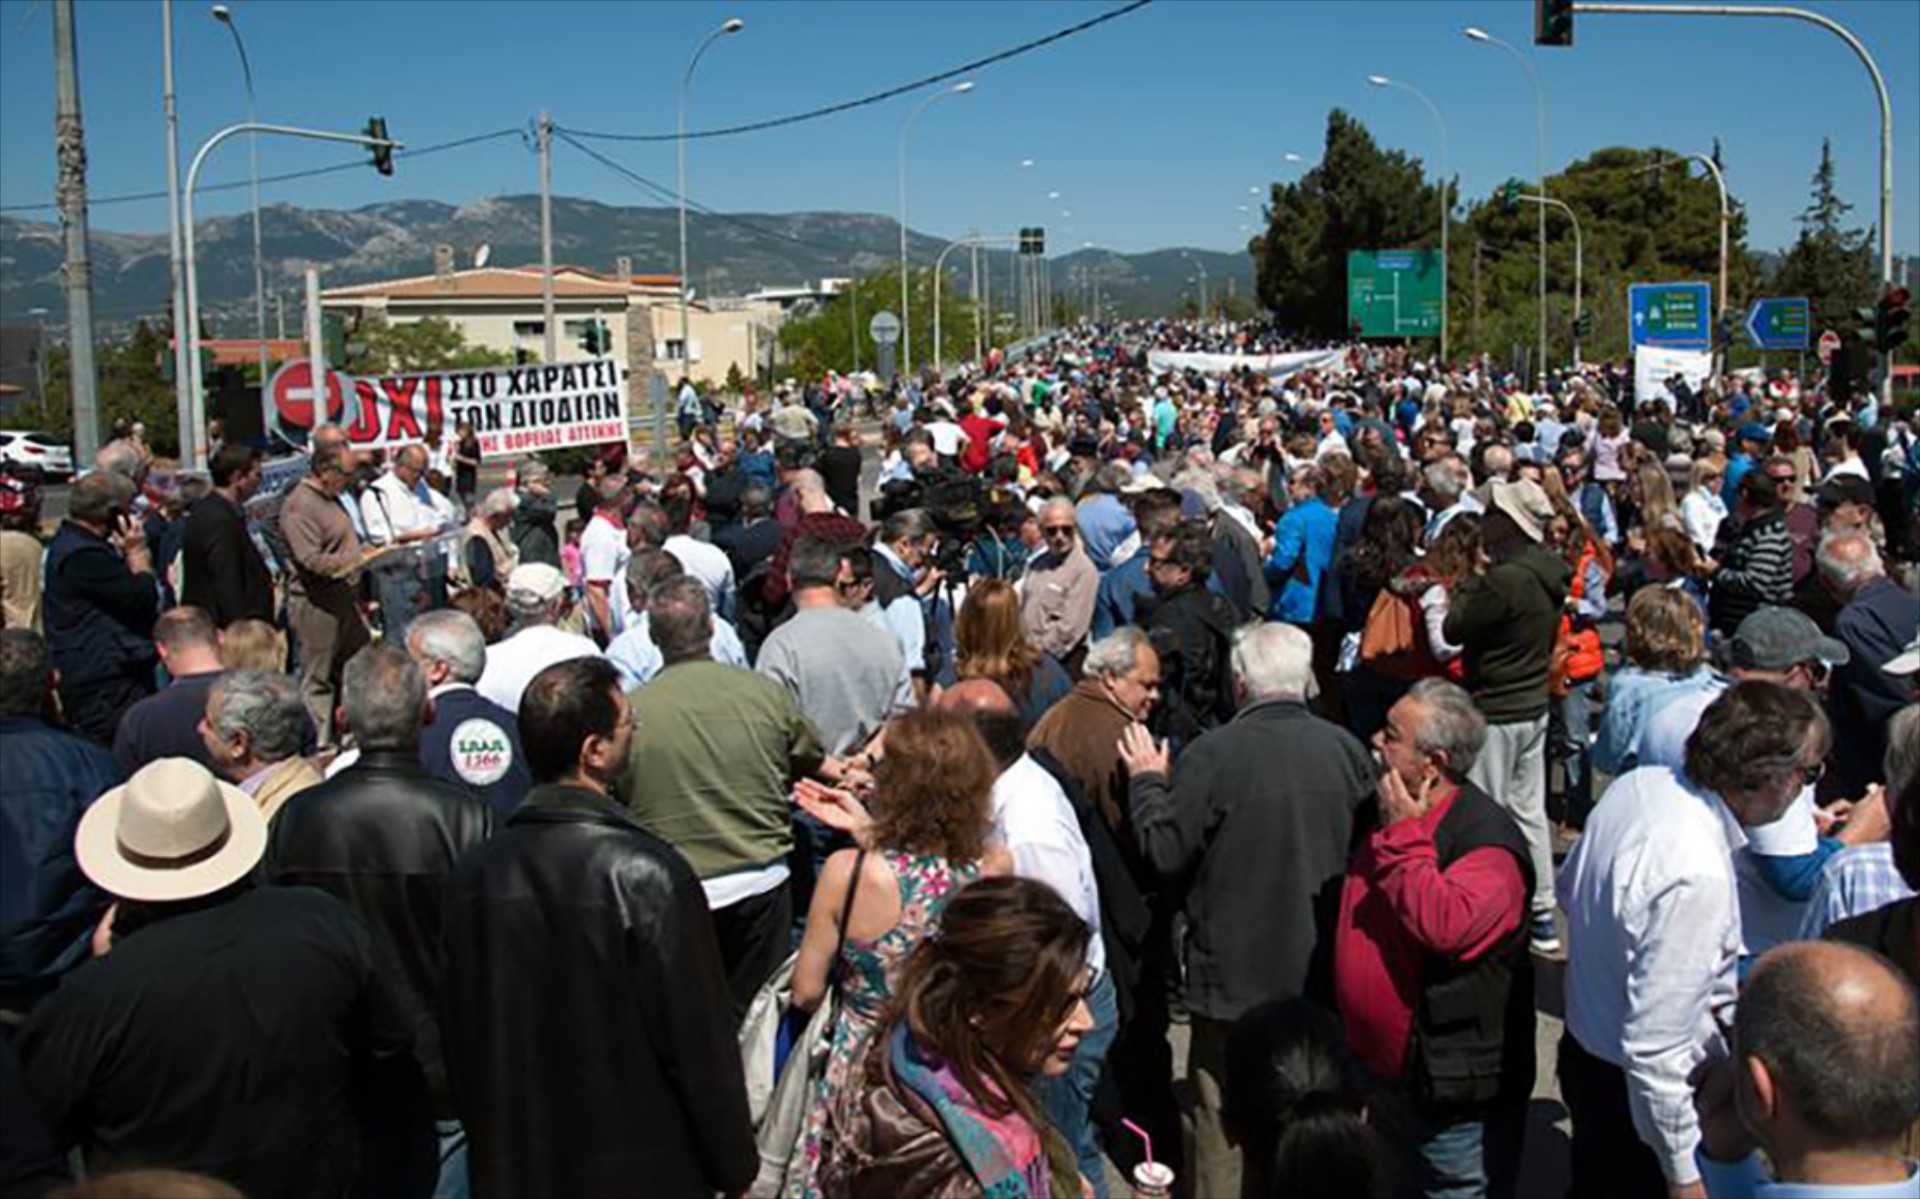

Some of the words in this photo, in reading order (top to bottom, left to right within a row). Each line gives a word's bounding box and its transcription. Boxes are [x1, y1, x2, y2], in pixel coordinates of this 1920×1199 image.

[449, 371, 497, 401] ΣΤΟ
[508, 360, 618, 396] ΧΑΡΑΤΣΙ
[451, 402, 502, 432] ΤΩΝ
[510, 392, 620, 428] ΔΙΟΔΙΩΝ
[504, 428, 563, 450] ΒΟΡΕΙΑΣ
[567, 422, 623, 442] ΑΤΤΙΚΗΣ
